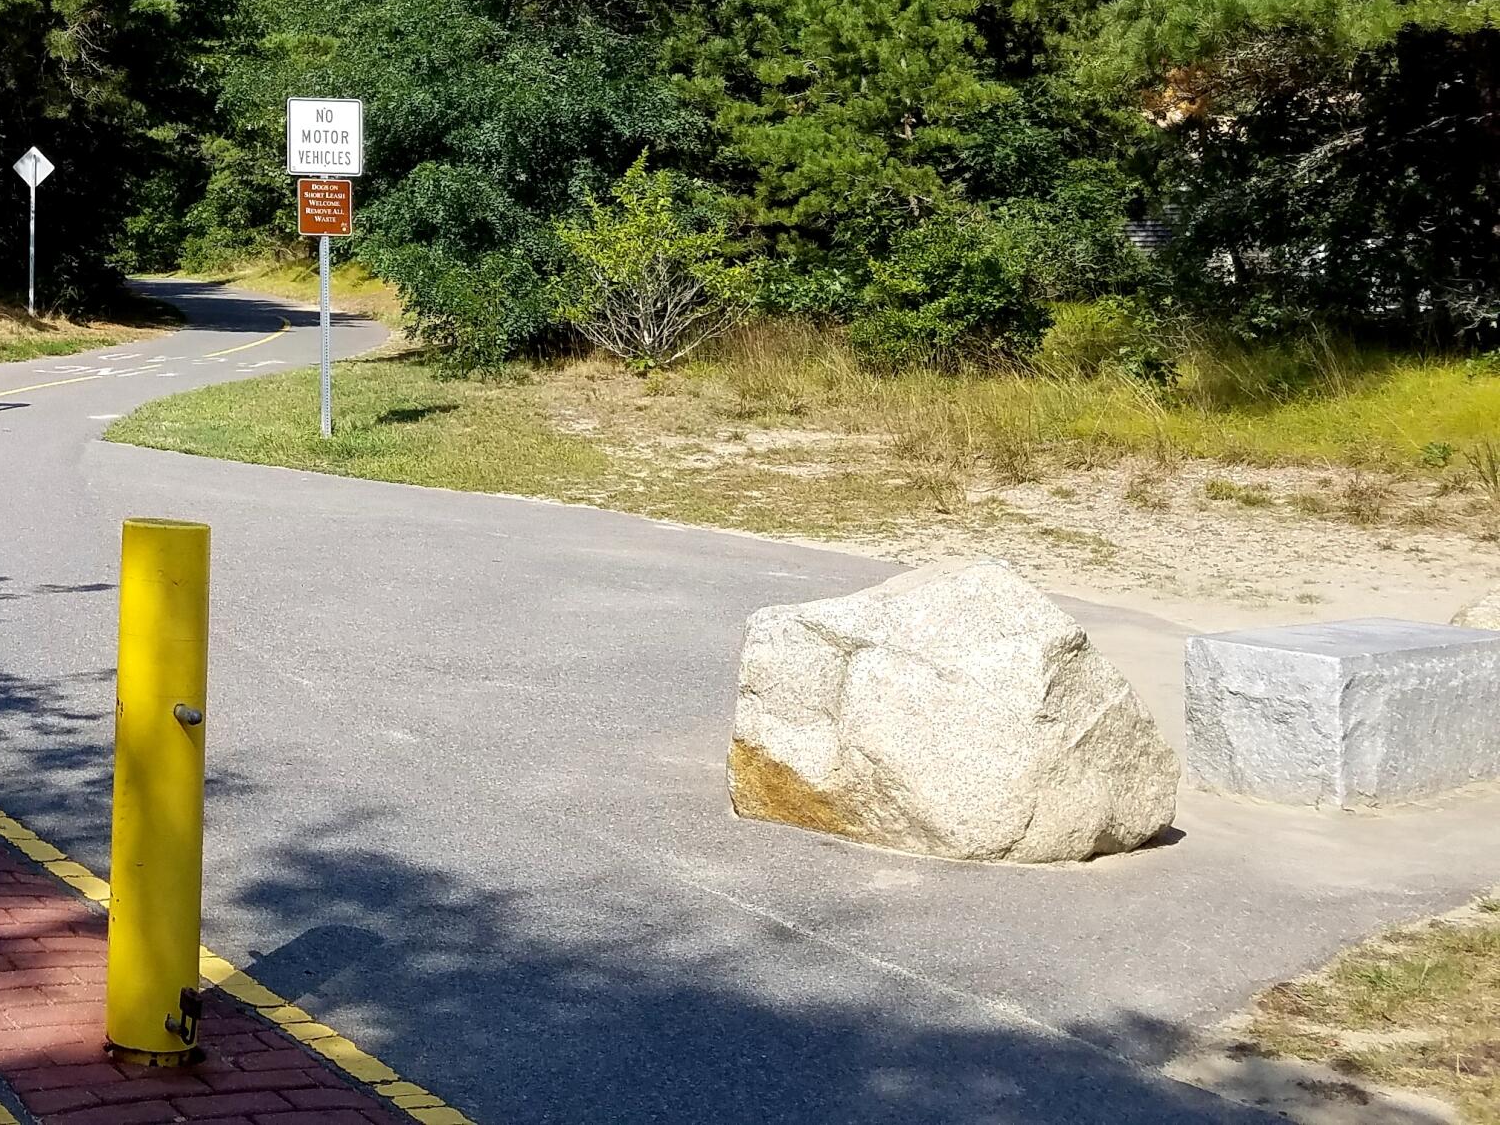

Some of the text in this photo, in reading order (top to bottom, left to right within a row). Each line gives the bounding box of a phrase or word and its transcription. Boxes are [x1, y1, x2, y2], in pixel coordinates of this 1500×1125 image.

[316, 109, 333, 123] NO
[302, 129, 349, 144] MOTOR
[298, 150, 351, 165] VEHICLES
[304, 191, 324, 199] SHORT
[305, 207, 333, 215] REMOVE
[314, 215, 337, 223] WASTE
